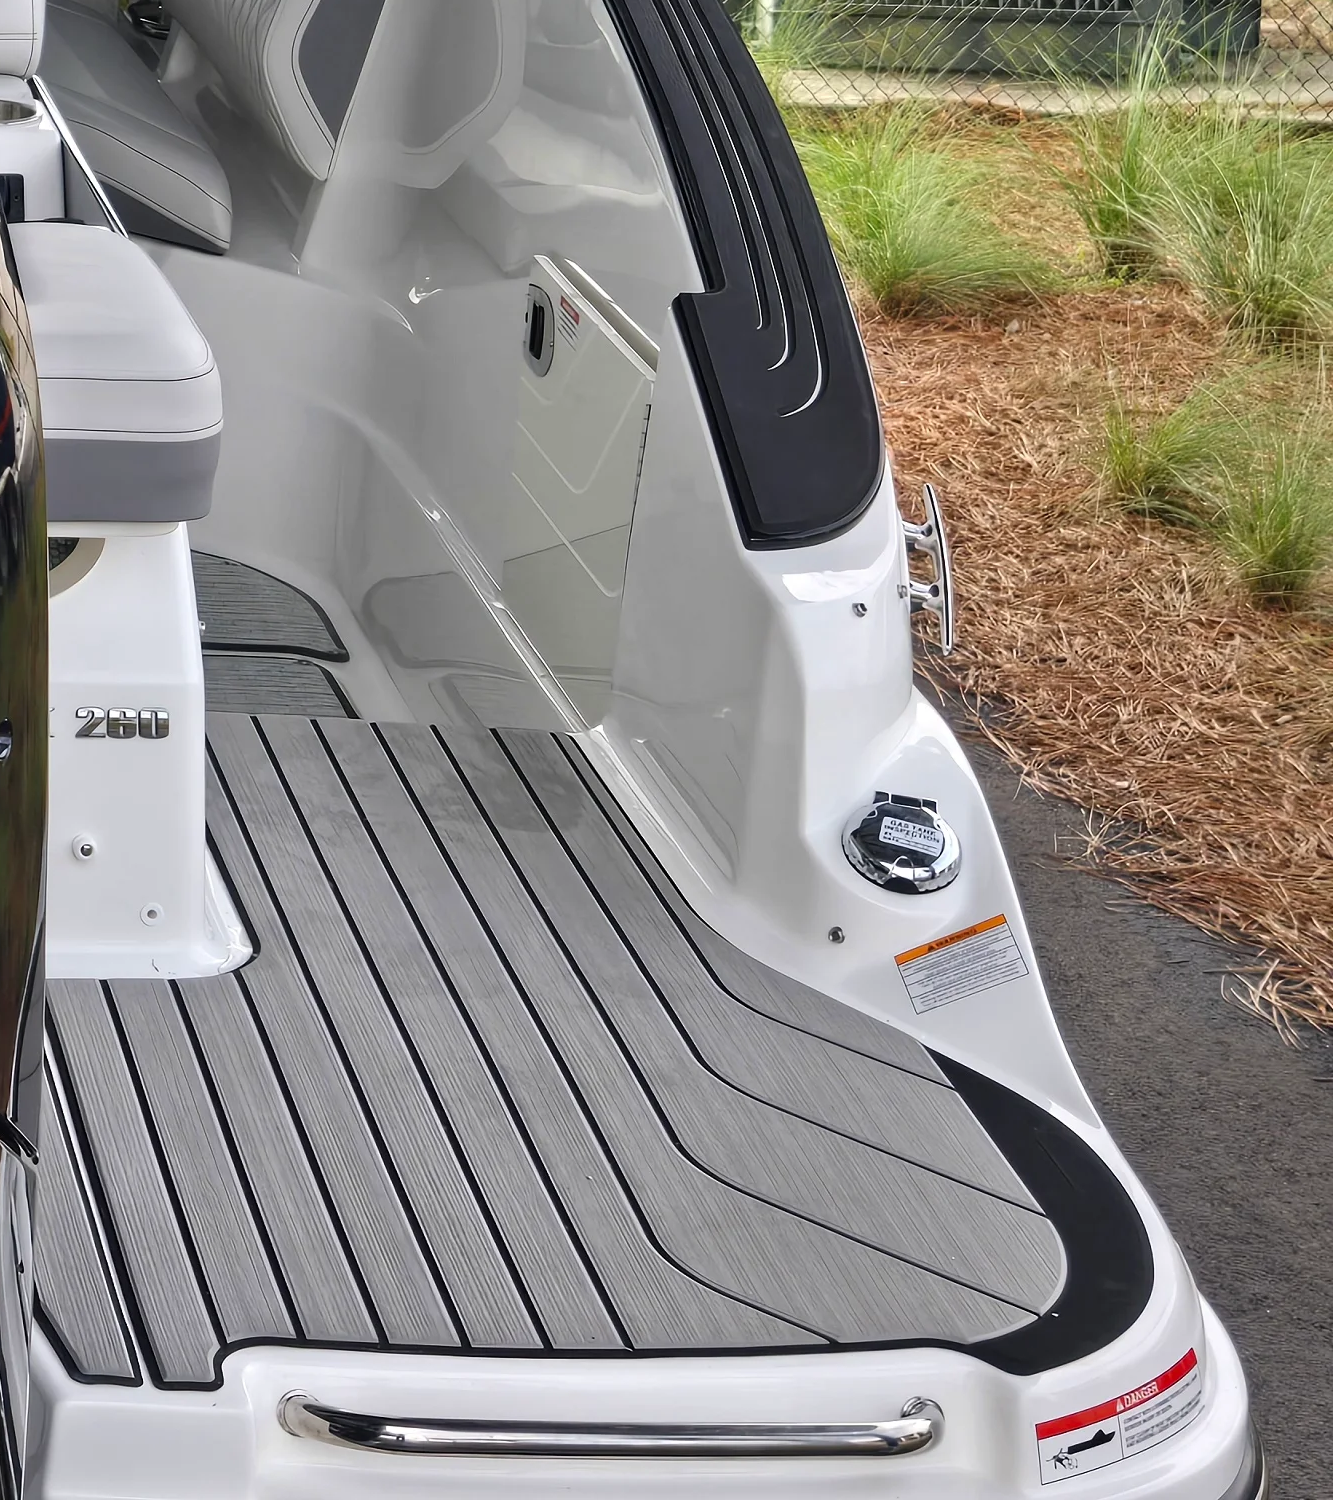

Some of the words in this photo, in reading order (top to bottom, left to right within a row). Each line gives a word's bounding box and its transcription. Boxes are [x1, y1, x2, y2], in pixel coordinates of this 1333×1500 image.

[74, 706, 171, 739] 260
[890, 819, 909, 829] GAS
[1123, 1381, 1159, 1407] DANGER
